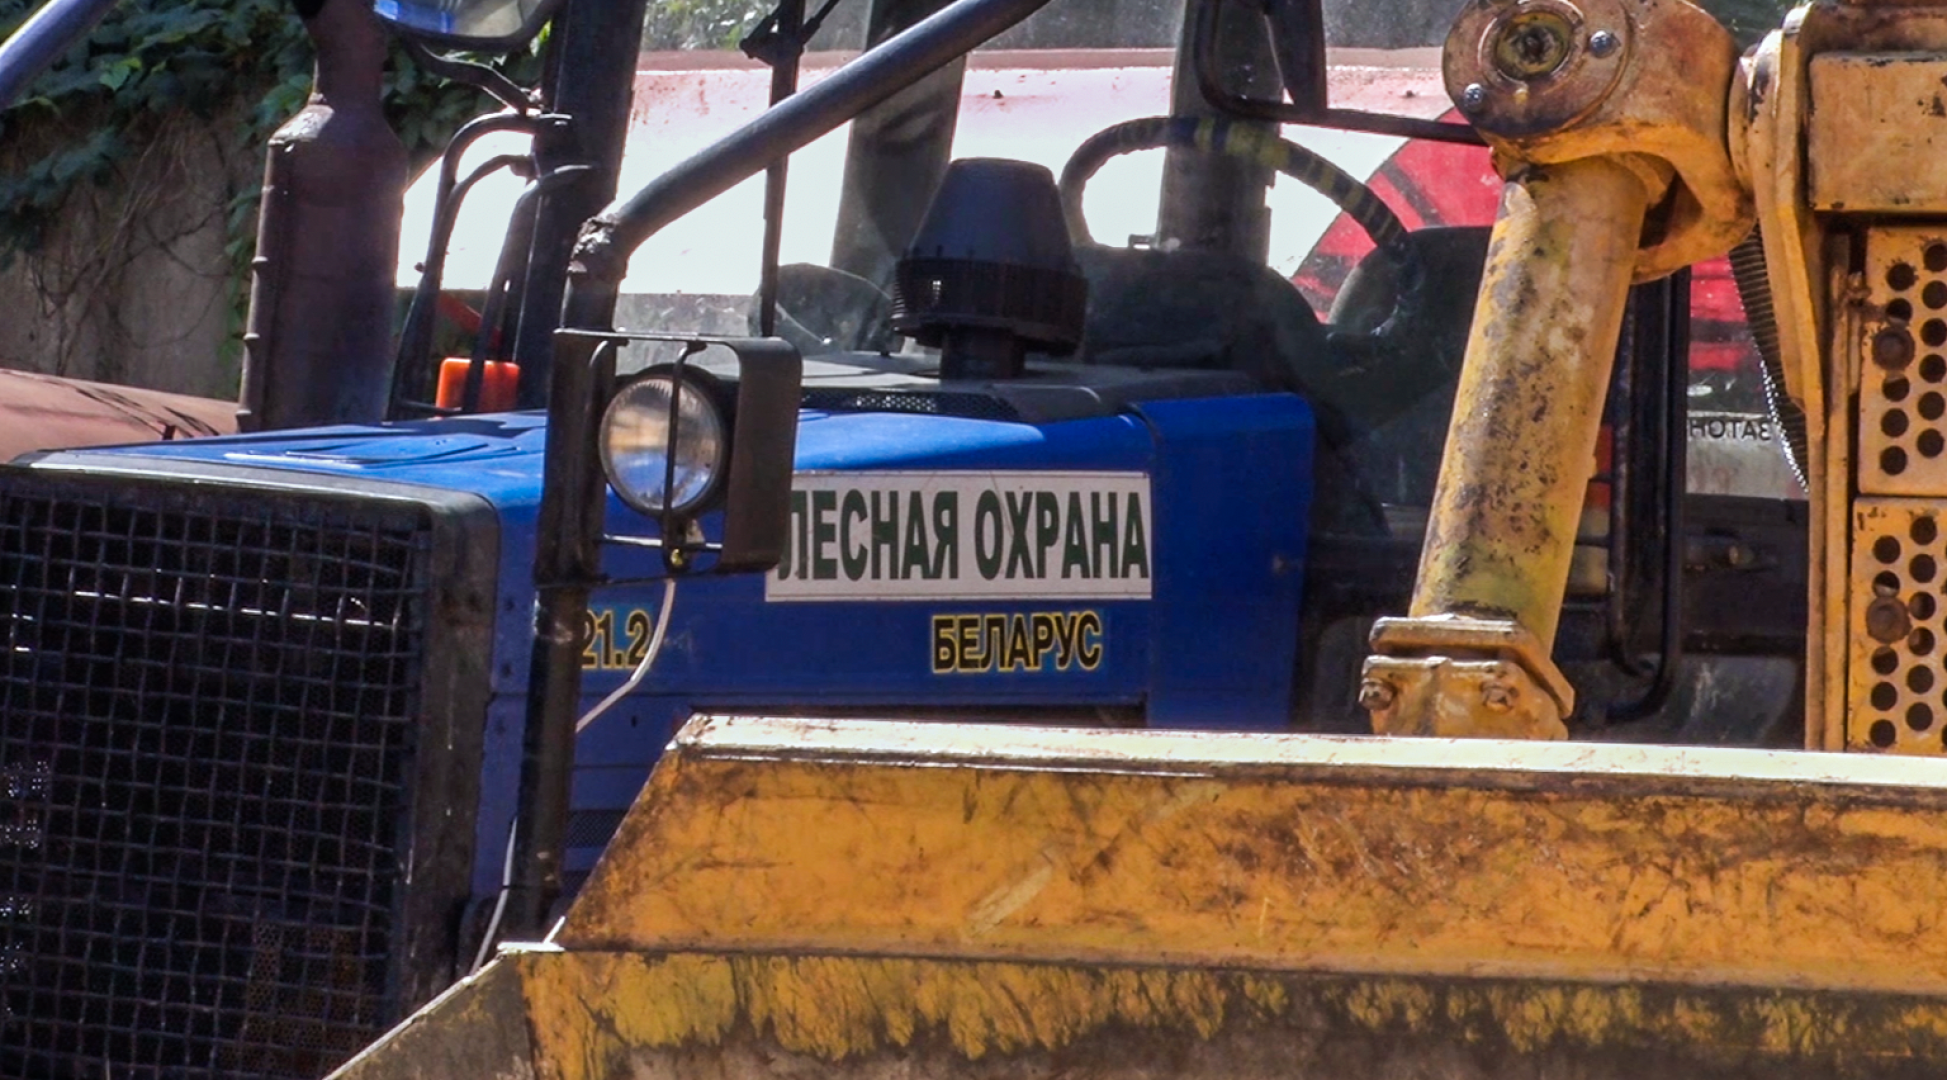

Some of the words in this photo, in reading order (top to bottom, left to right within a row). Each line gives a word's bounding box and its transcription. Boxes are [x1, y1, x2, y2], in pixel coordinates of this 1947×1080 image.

[778, 489, 959, 581] ЛЕСНАЯ
[975, 490, 1149, 581] ОХРАНА
[932, 610, 1102, 674] БЕЛАРУС
